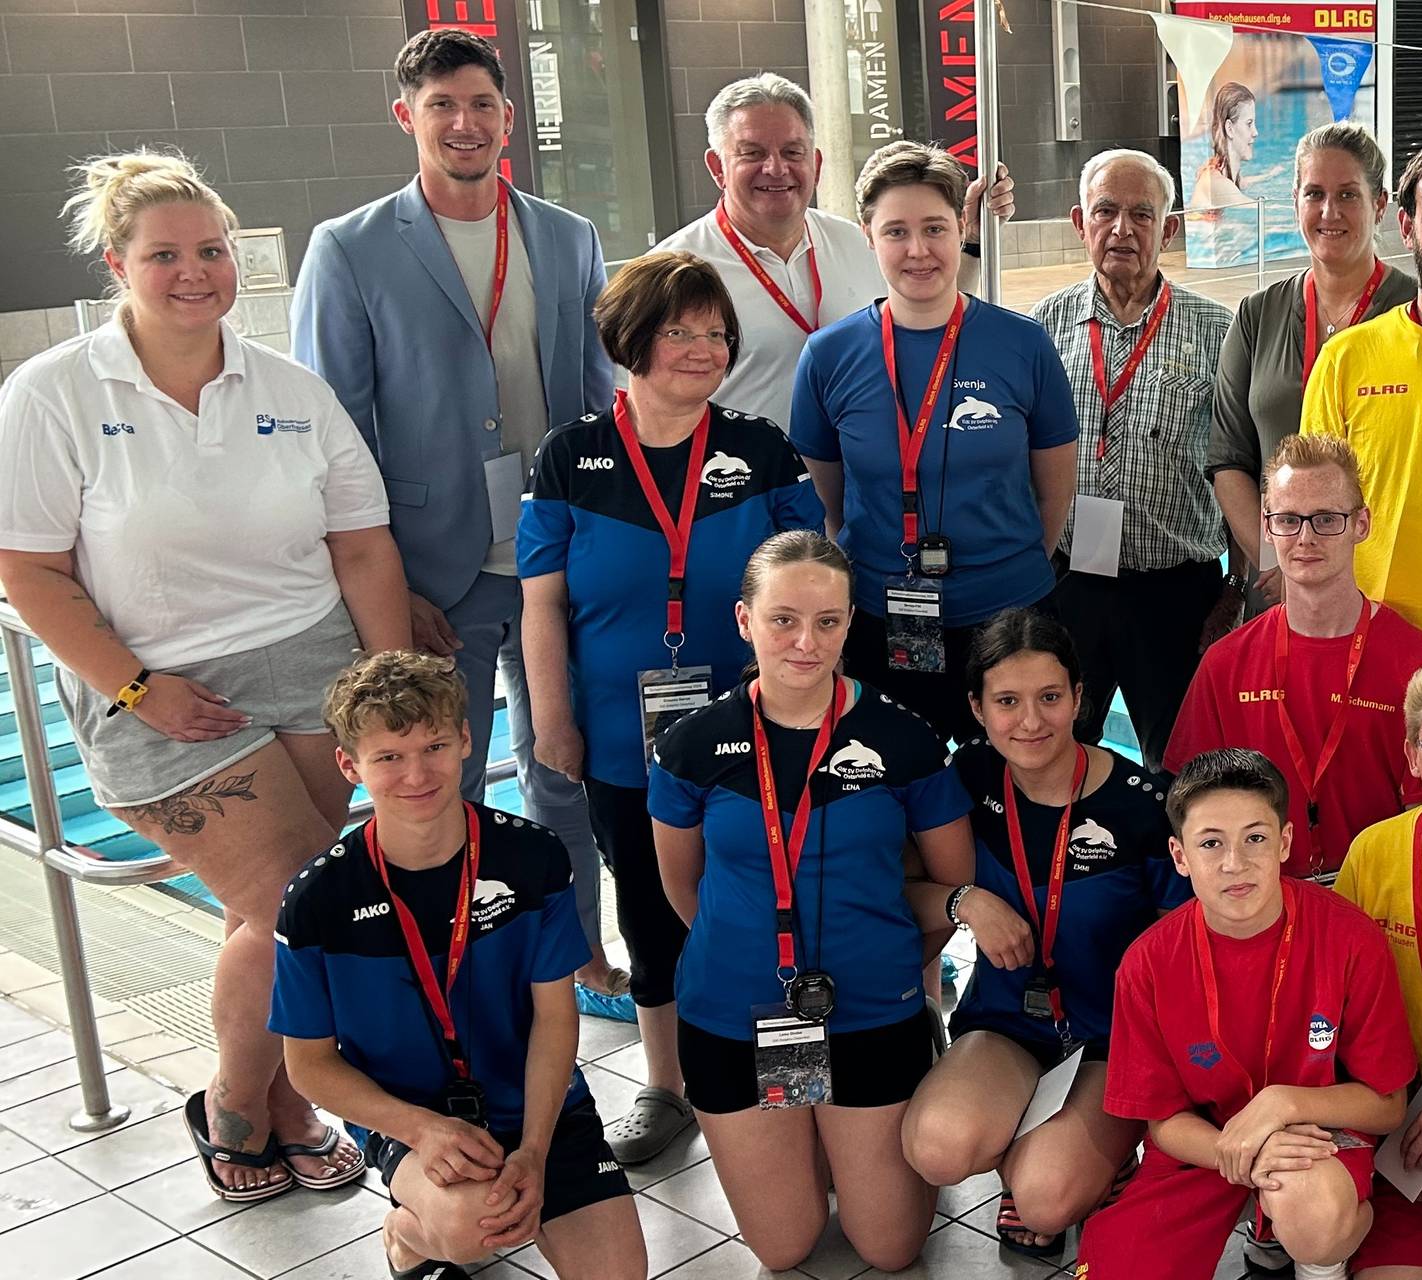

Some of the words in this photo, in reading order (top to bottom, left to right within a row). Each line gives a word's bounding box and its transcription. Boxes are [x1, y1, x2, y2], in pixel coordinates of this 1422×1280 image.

[1314, 9, 1373, 28] DLRG
[529, 41, 563, 151] HERREN
[865, 42, 890, 139] DAMEN
[1358, 384, 1408, 396] DLRG
[577, 457, 614, 470] JAKO
[1331, 693, 1343, 704] M.
[715, 741, 751, 755] JAKO
[842, 783, 860, 791] LENA
[353, 902, 390, 921] JAKO
